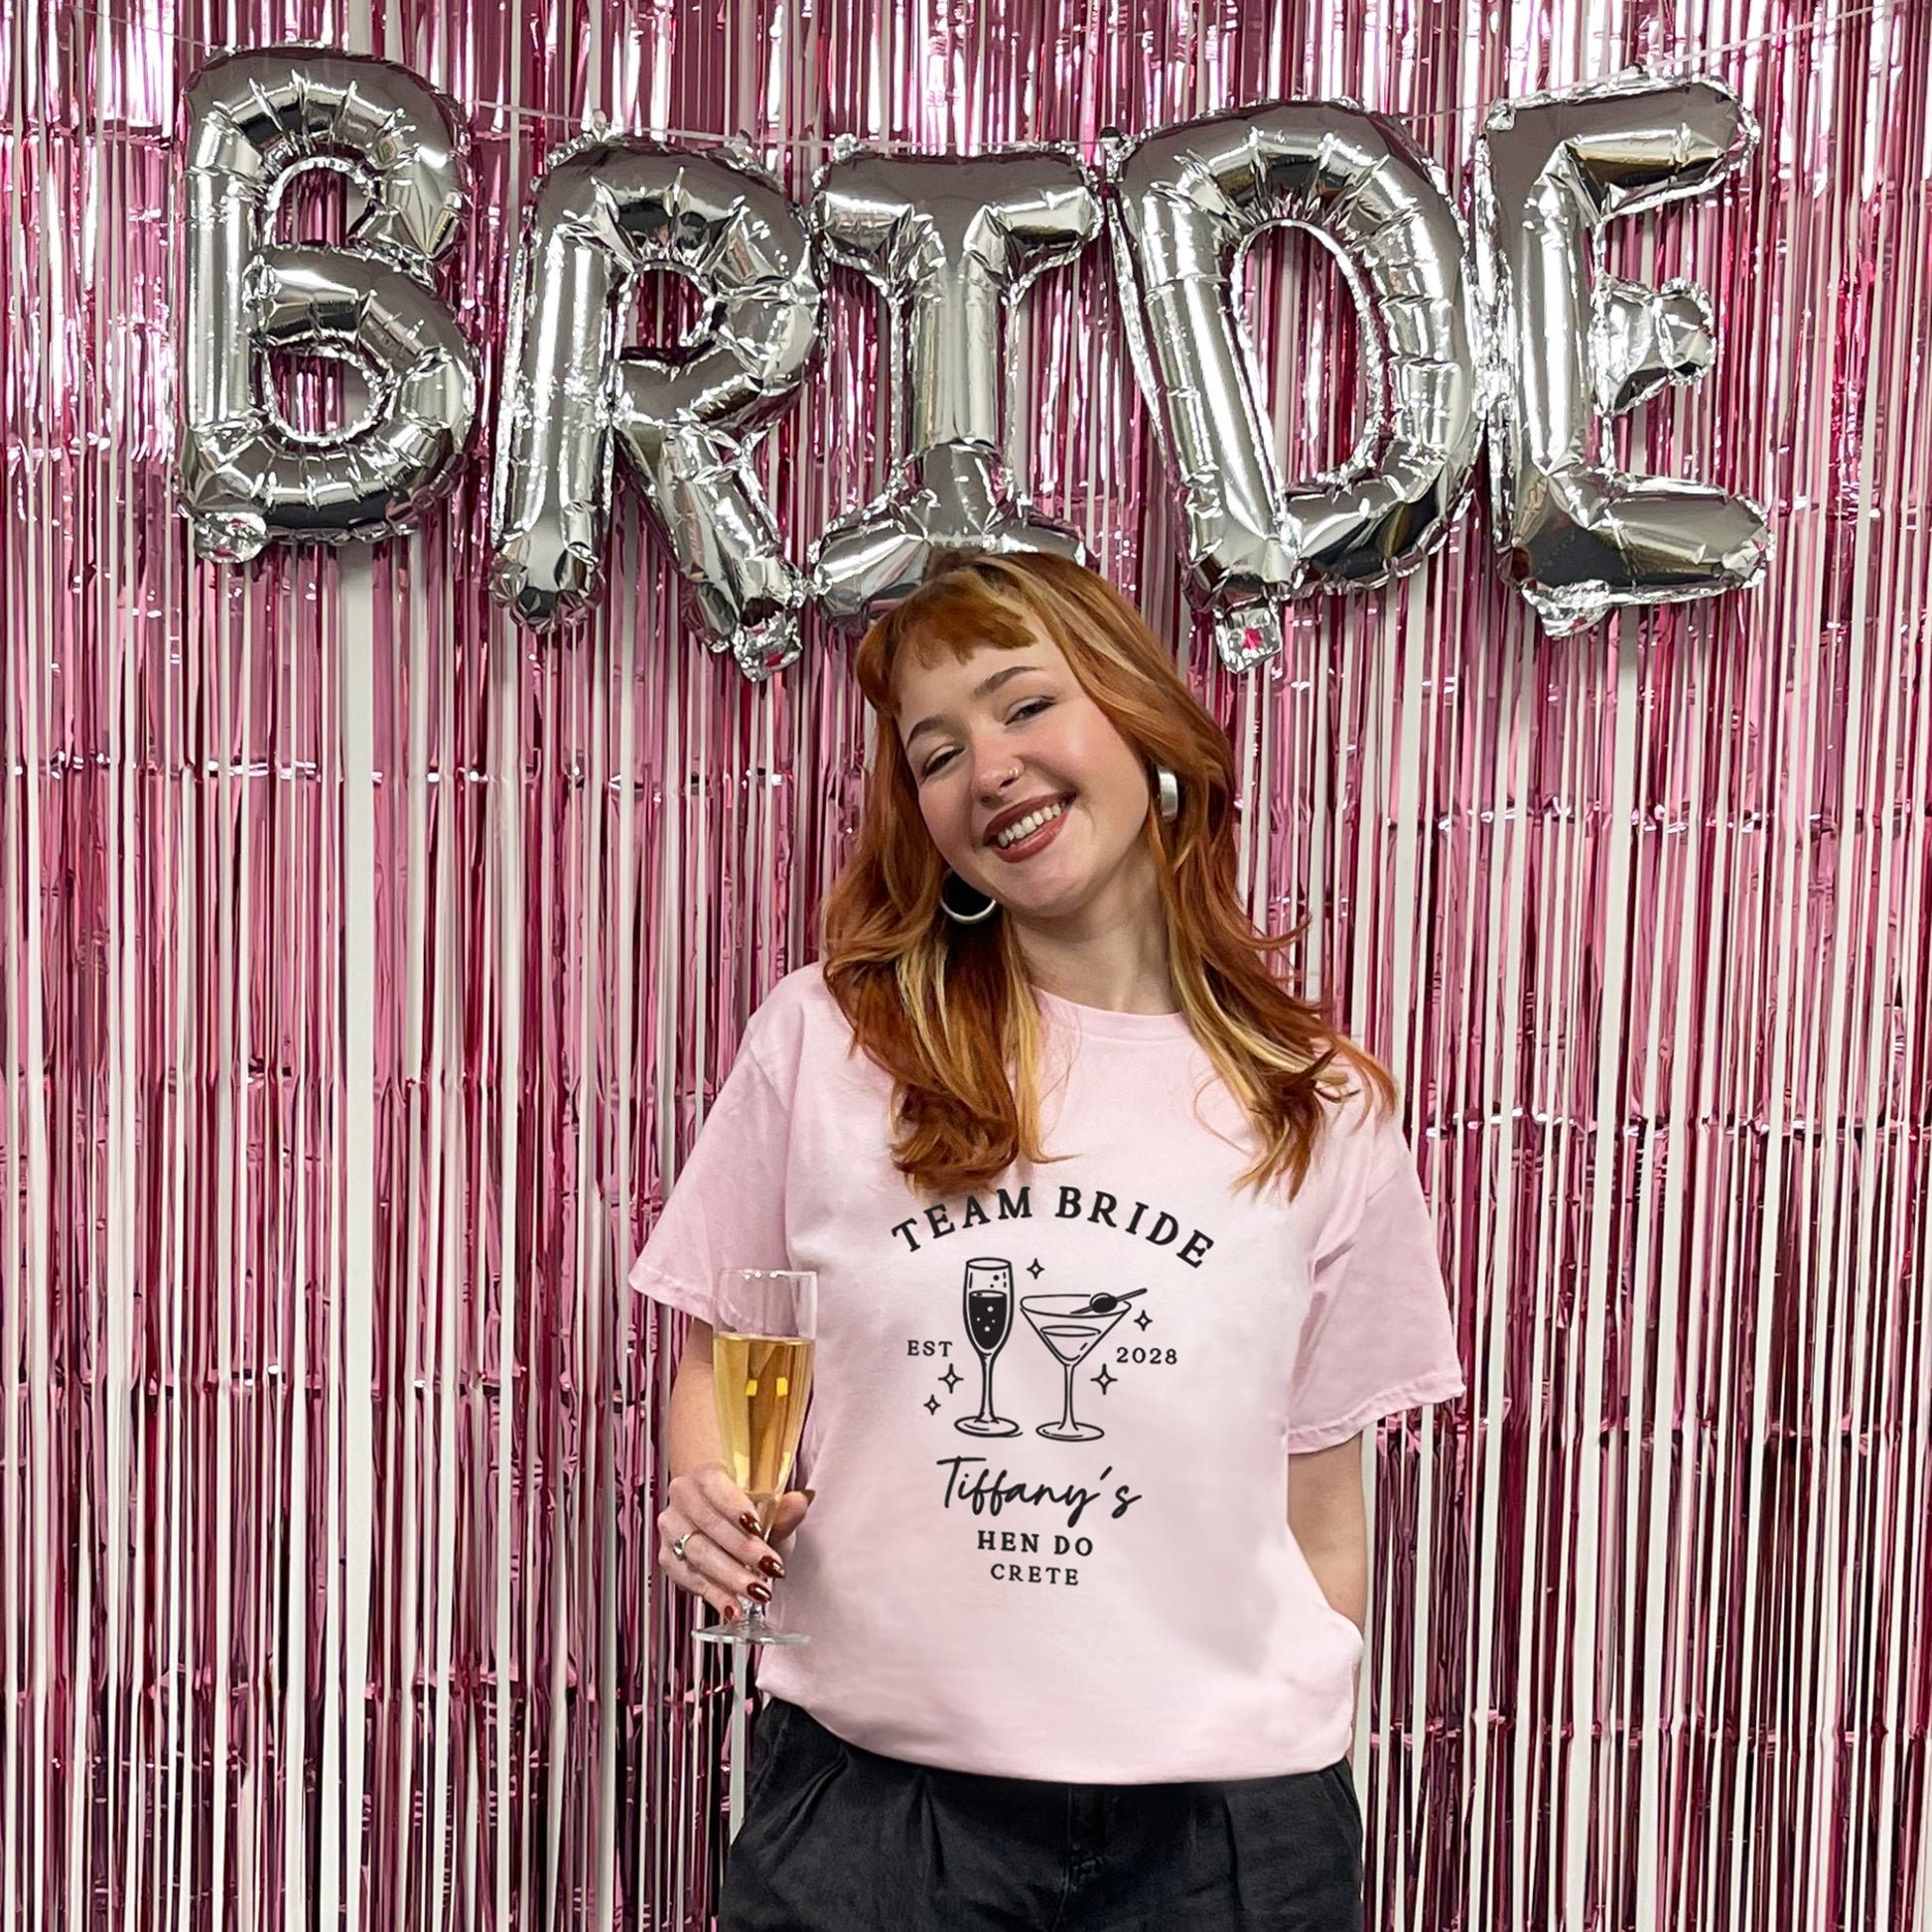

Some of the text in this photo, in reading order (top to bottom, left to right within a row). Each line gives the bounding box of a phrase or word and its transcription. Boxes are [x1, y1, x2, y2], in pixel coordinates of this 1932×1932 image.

[177, 42, 1777, 679] BRIDE
[891, 1185, 1215, 1270] TEAM BRIDE
[905, 1339, 1178, 1366] EST 2028
[935, 1454, 1143, 1529] Tiffany's
[976, 1529, 1094, 1558] HEN DO
[990, 1563, 1080, 1587] CRETE
